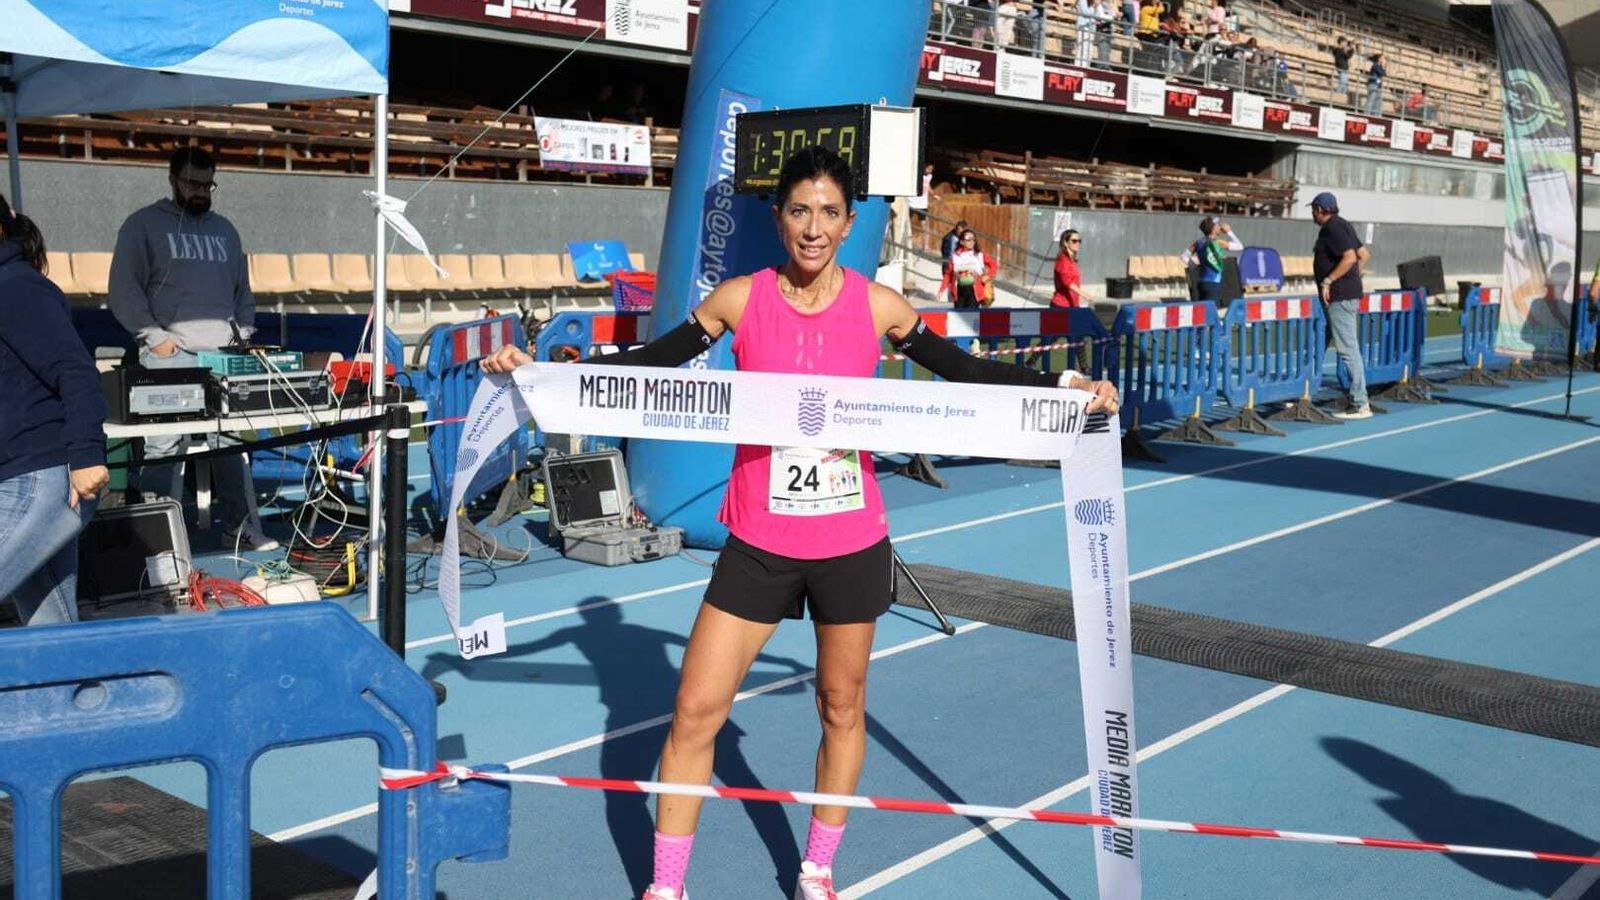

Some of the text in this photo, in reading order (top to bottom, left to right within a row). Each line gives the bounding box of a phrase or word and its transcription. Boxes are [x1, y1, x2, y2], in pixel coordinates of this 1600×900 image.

[279, 3, 315, 16] Deportes
[1048, 74, 1080, 92] PLAY
[579, 374, 732, 415] MEDIA MARATON
[834, 398, 976, 418] Ayuntamiento de Jerez
[642, 412, 730, 431] CIUDAD DE JEREZ
[833, 413, 883, 427] Deportes
[1021, 398, 1079, 434] MEDIA
[787, 465, 820, 492] 24
[1088, 532, 1098, 579] Deportes
[1098, 532, 1116, 668] Ayuntamiento de Jerez
[1105, 710, 1130, 768] MEDIA
[1098, 769, 1110, 810] CIUDAD
